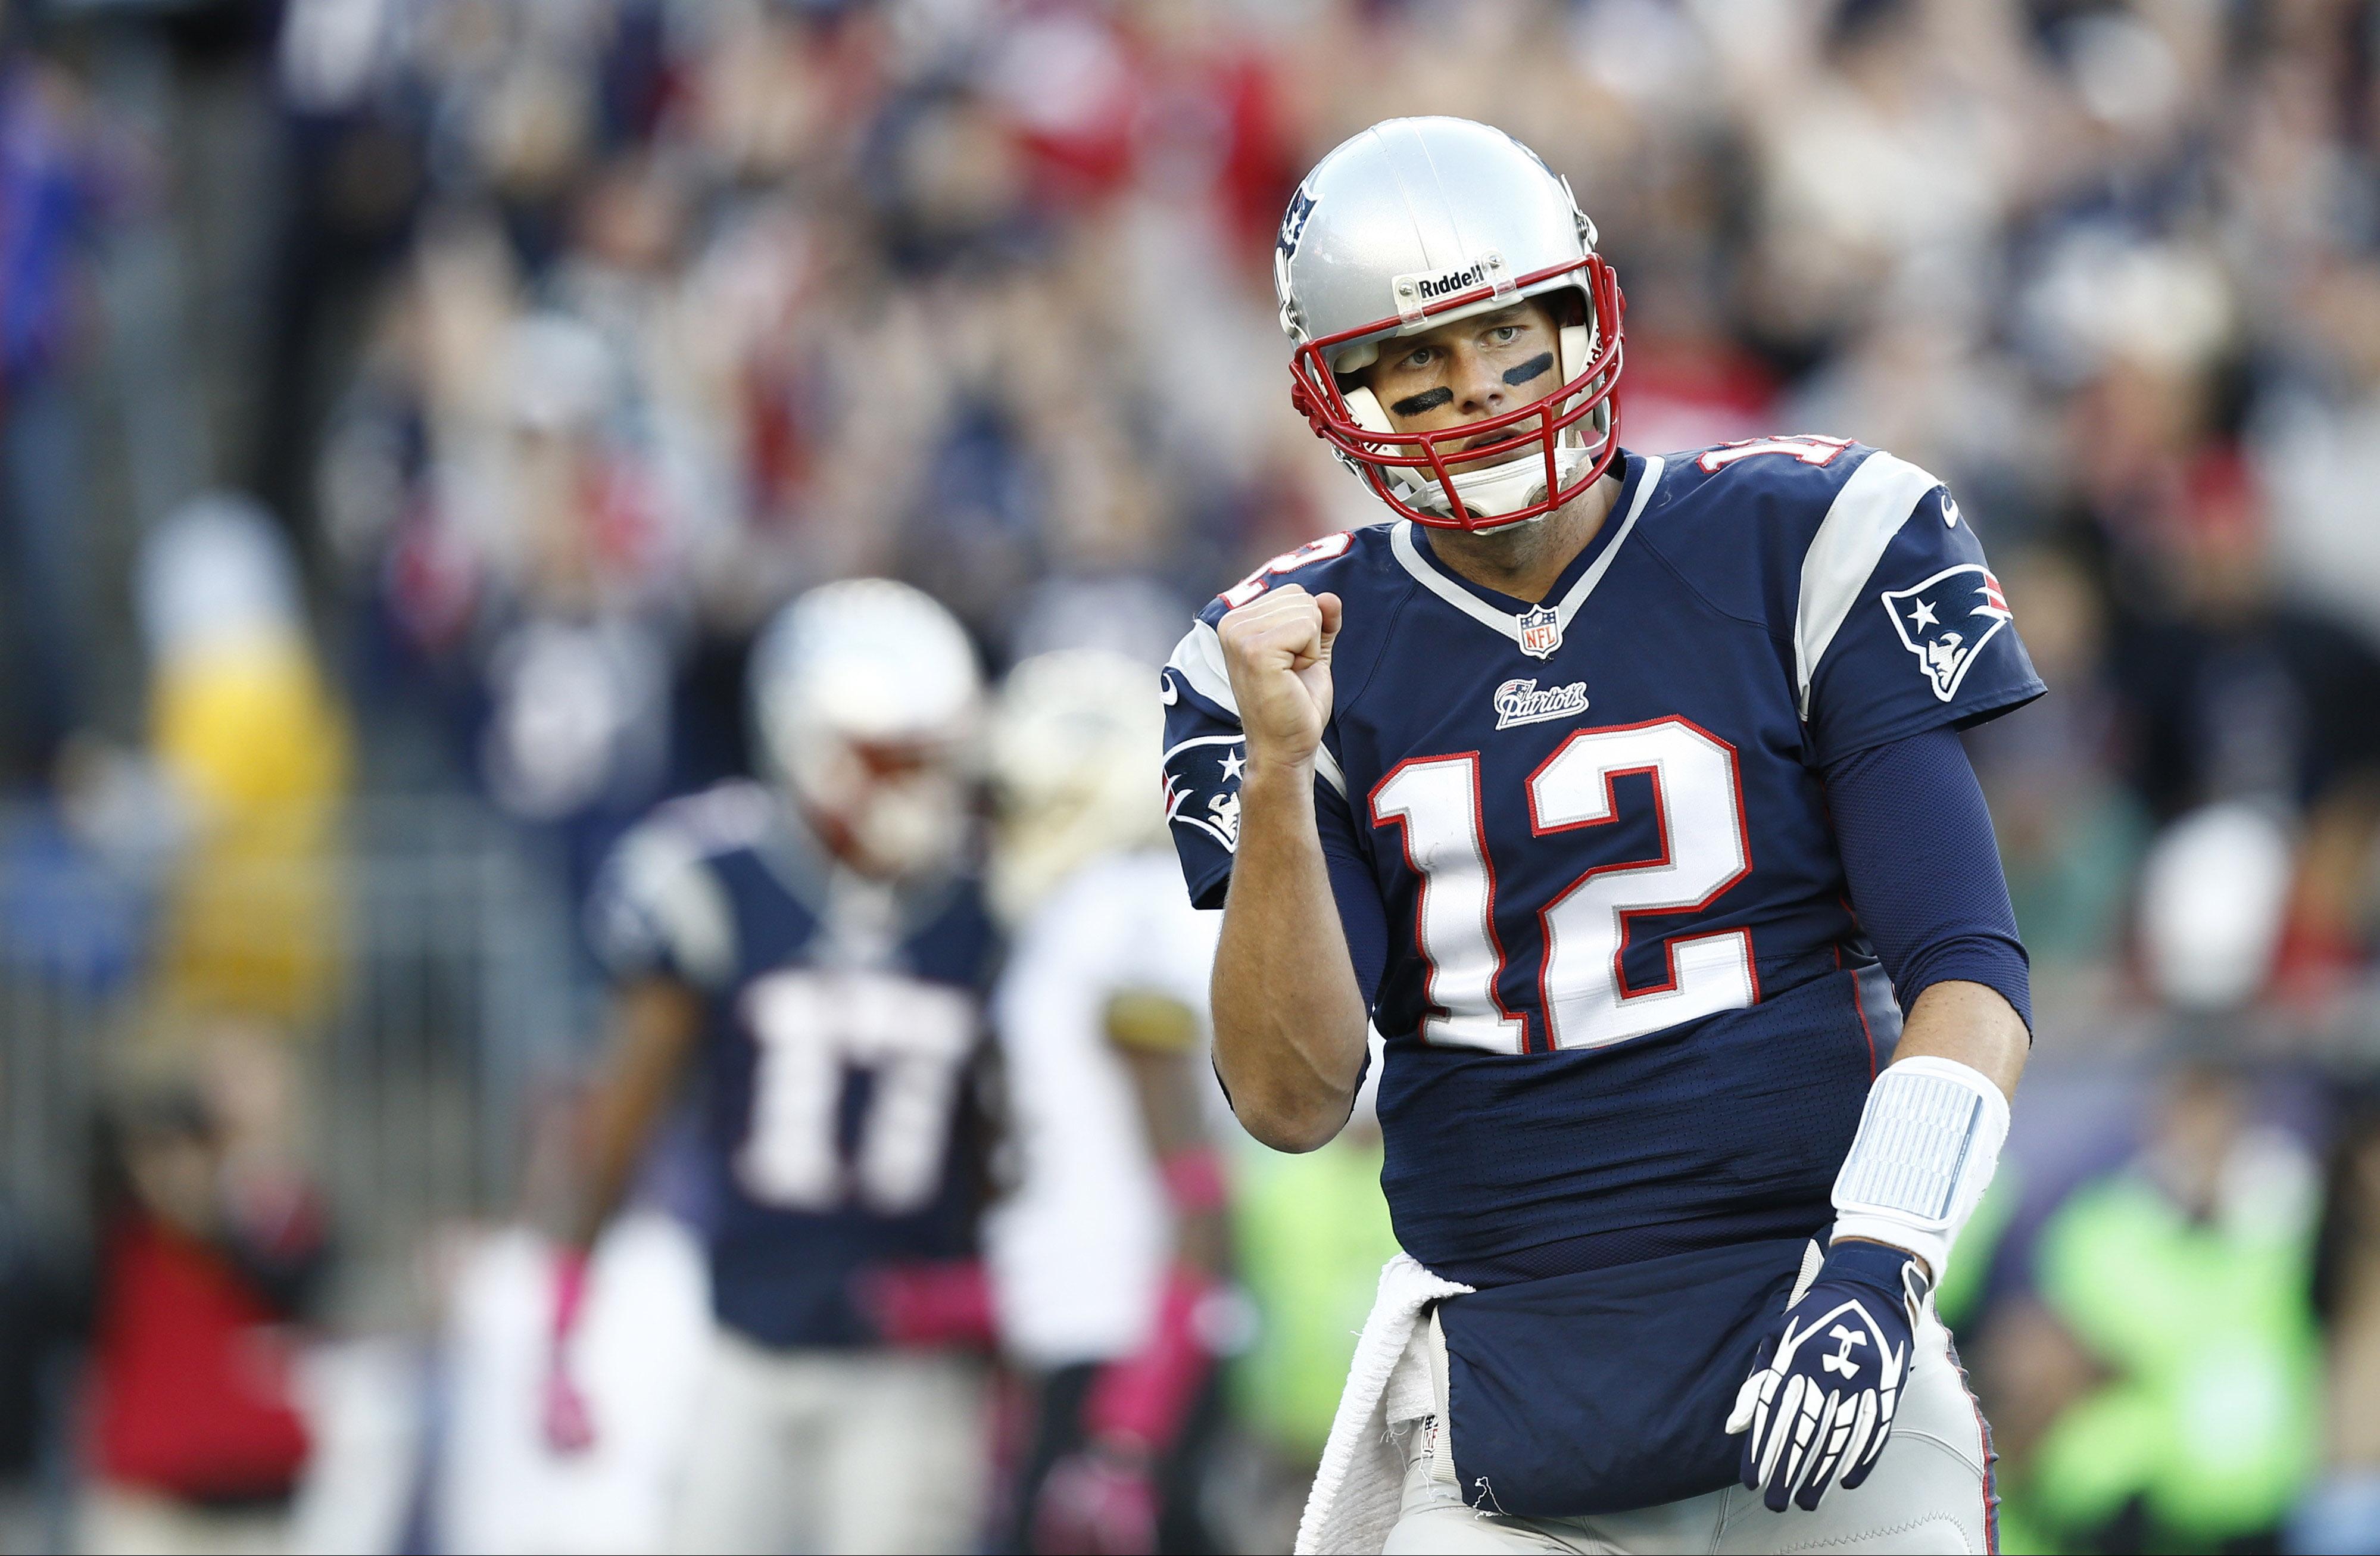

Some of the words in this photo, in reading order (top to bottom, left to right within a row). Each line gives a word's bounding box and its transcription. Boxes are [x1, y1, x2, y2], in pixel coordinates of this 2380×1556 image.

[1419, 264, 1484, 298] Riddell
[1525, 626, 1555, 648] NFL
[1497, 682, 1586, 726] Patriots
[1368, 714, 1760, 1055] 12
[737, 968, 980, 1214] 17
